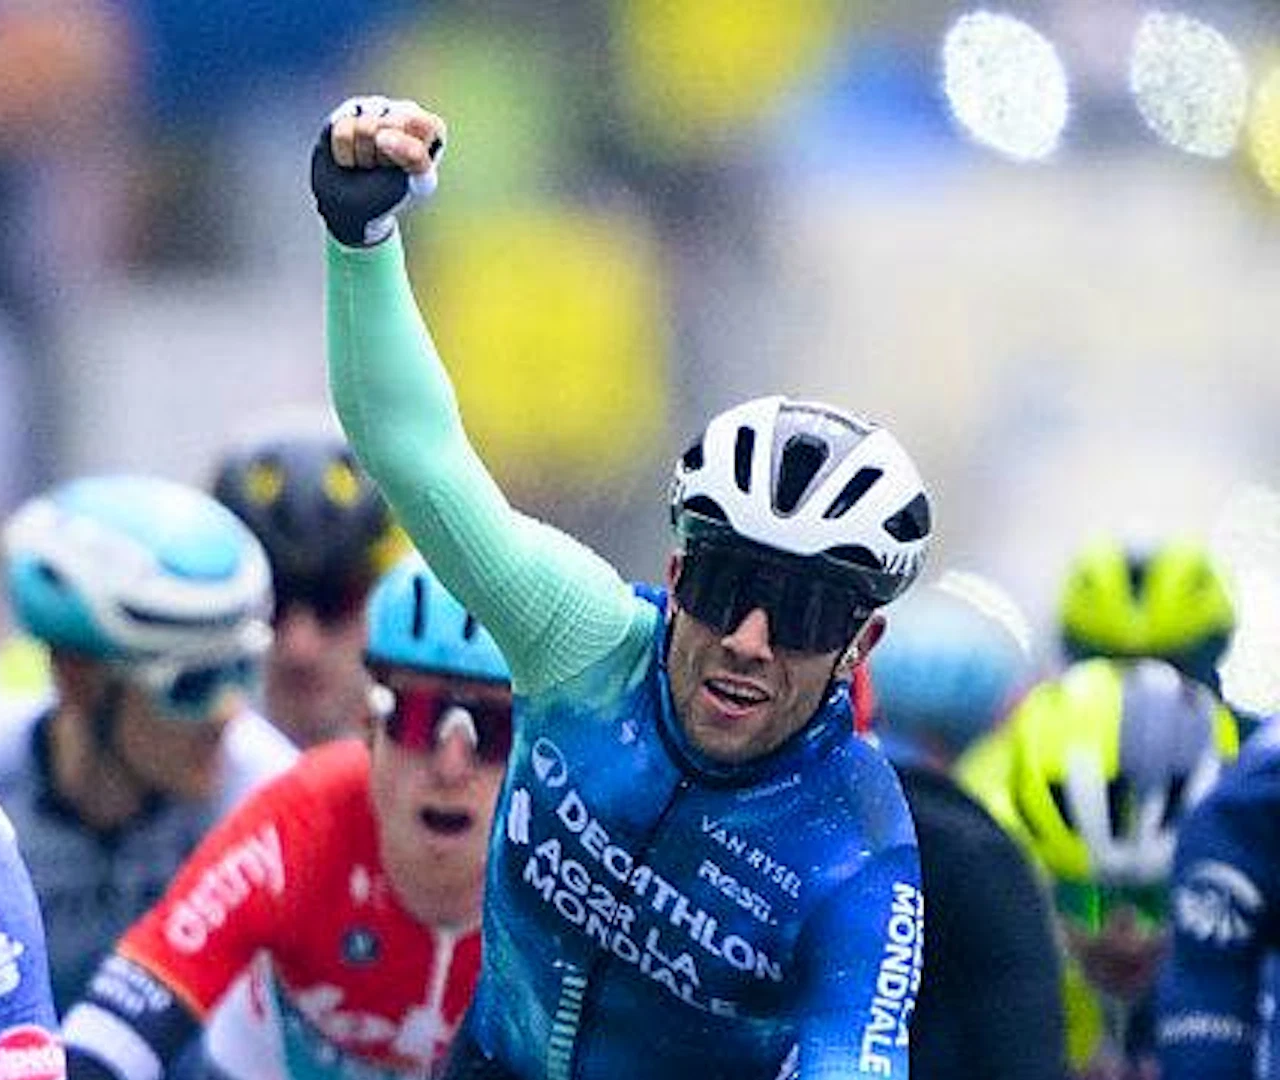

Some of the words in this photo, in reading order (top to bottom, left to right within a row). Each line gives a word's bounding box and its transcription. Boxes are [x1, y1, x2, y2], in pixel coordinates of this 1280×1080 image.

[523, 857, 737, 1019] MONDIALE
[535, 838, 636, 932] AG2R
[646, 928, 701, 988] LA
[557, 790, 783, 982] DECATHLON
[701, 816, 747, 856] VAN
[746, 849, 802, 899] RYSEL
[859, 881, 916, 1078] MONDIALE
